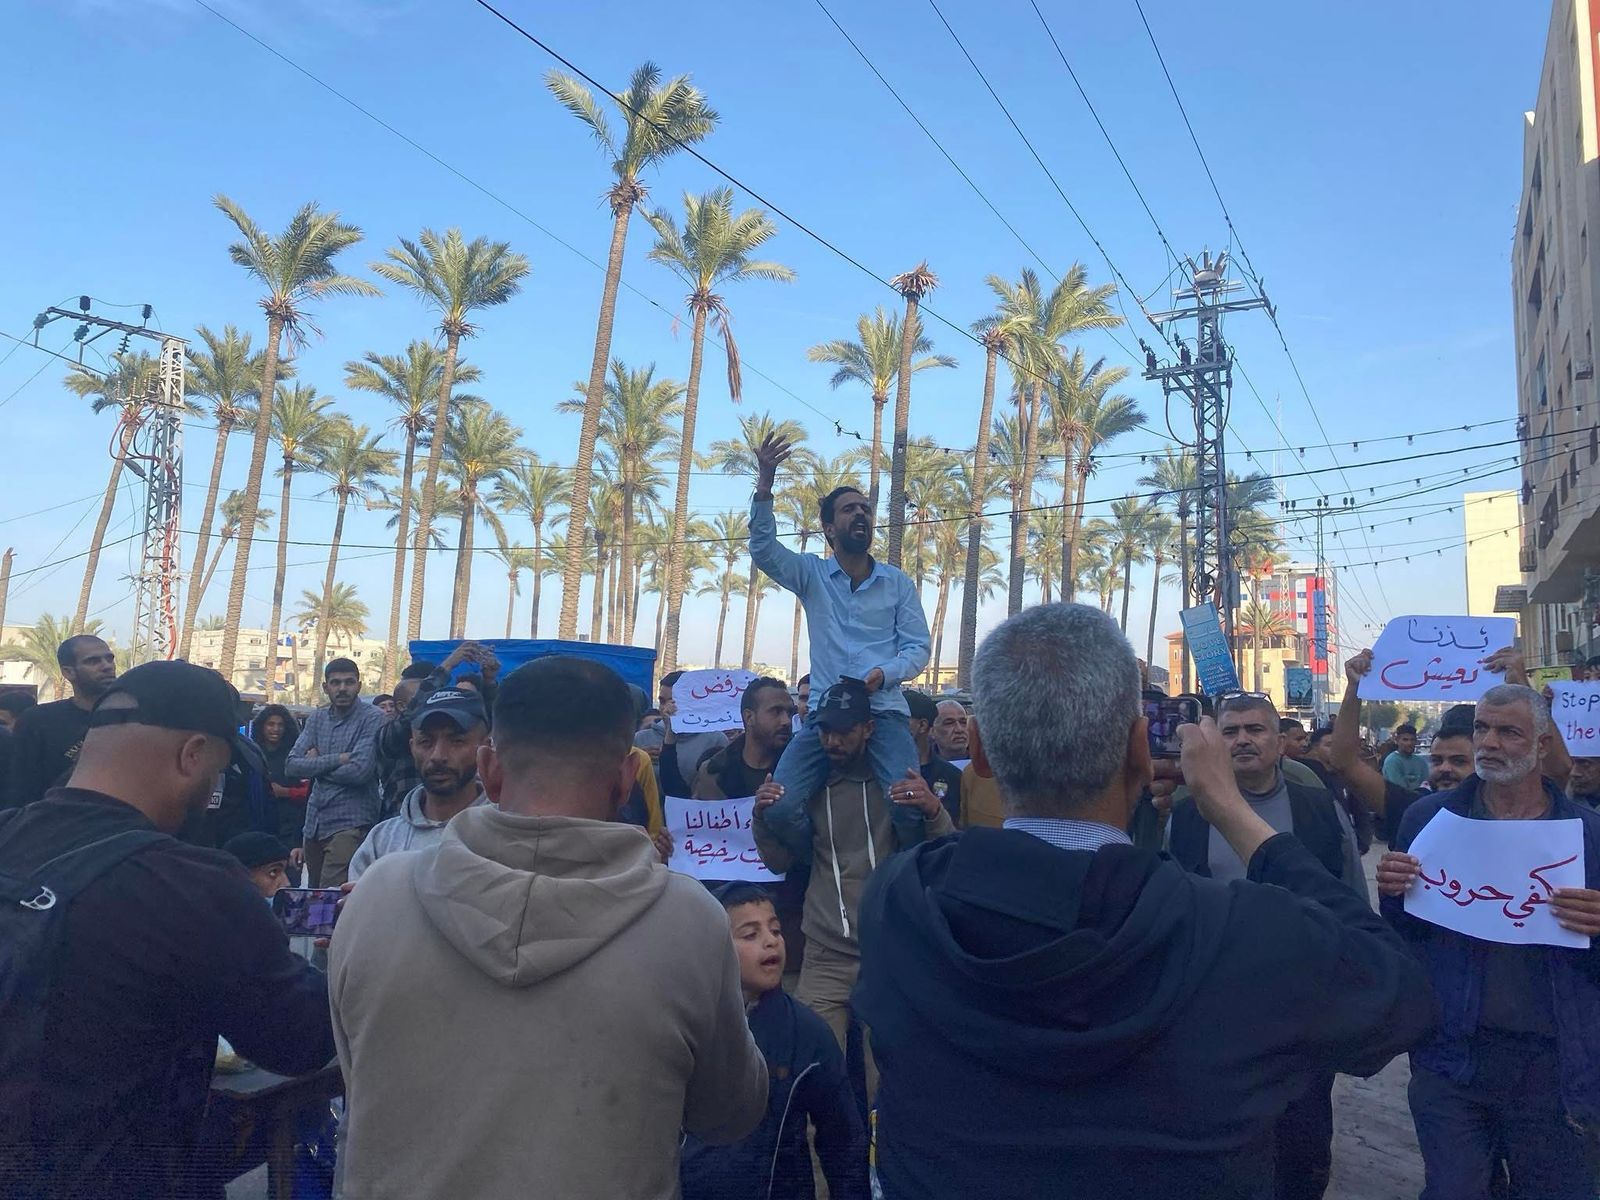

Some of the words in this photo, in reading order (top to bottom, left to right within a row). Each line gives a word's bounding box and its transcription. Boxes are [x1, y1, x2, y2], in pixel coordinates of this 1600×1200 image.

[1562, 692, 1600, 713] Stop
[682, 711, 732, 727] نموت
[1567, 720, 1596, 740] the
[685, 805, 740, 830] أطفالنا
[684, 834, 738, 865] رخيصة
